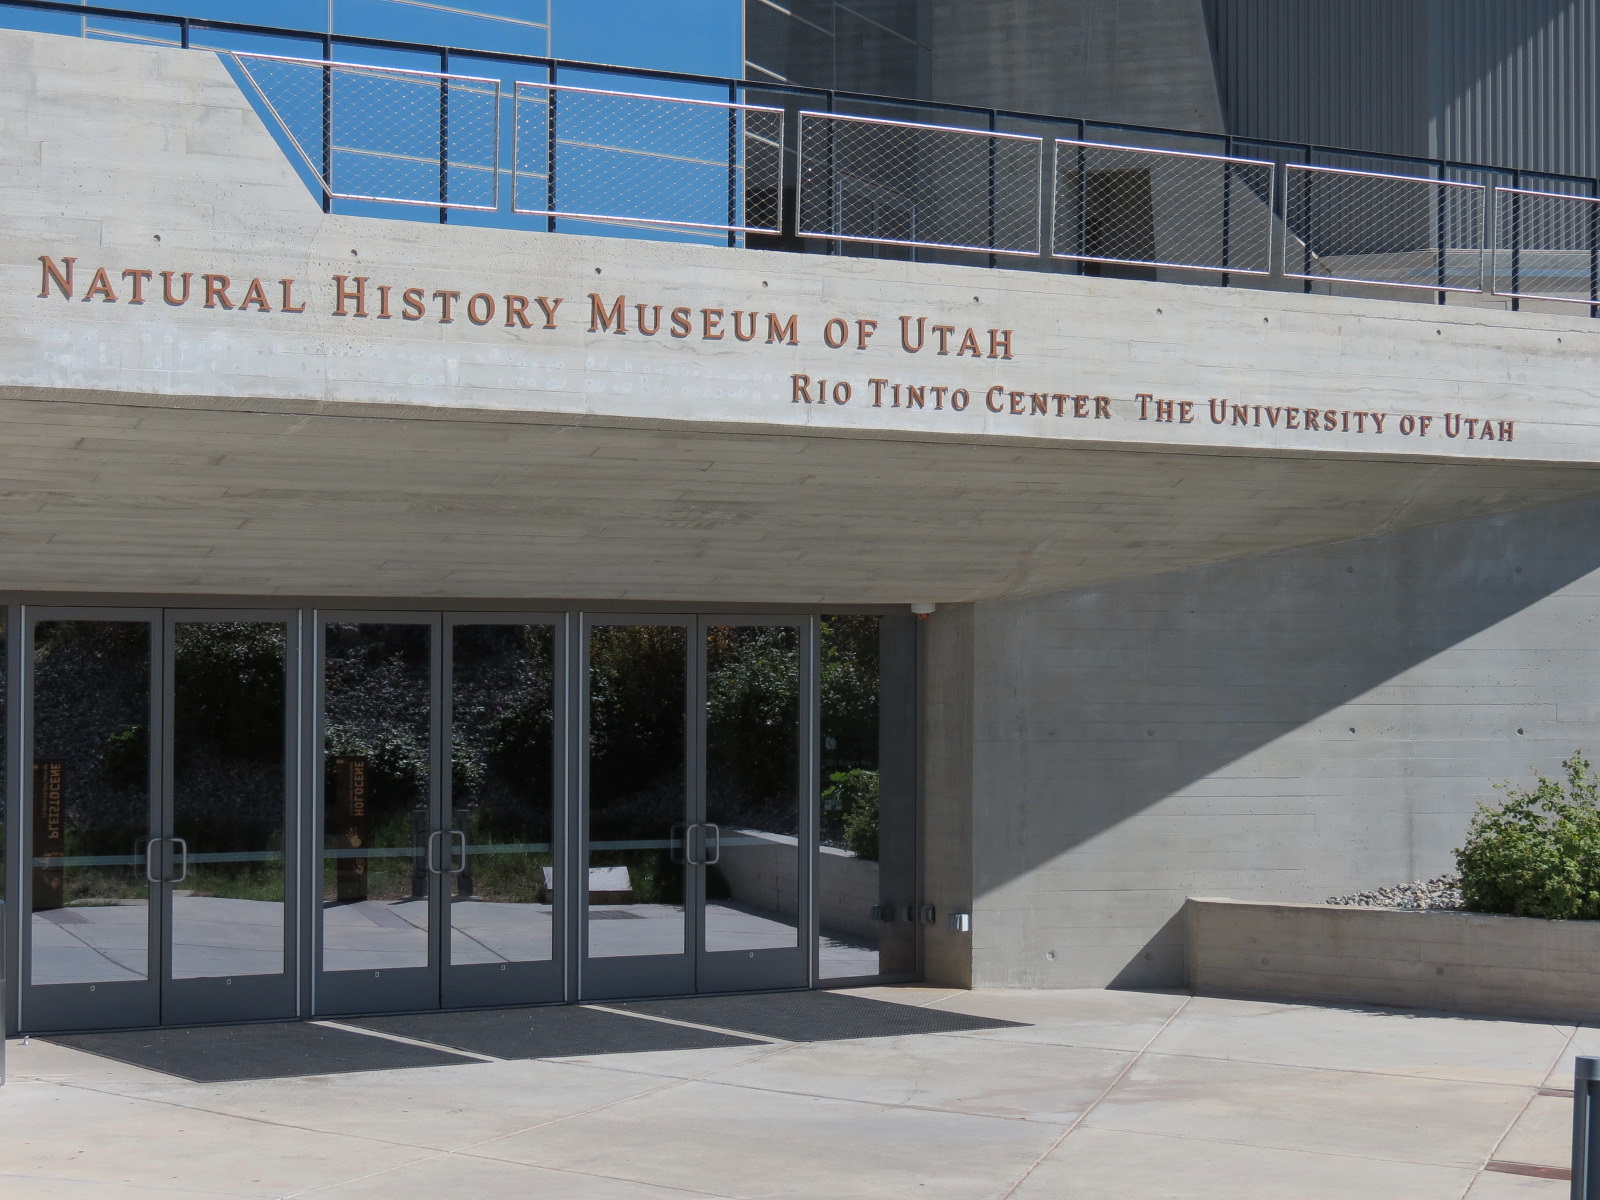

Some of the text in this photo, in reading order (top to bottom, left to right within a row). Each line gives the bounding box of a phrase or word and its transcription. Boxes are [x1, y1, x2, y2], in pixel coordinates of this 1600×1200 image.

[39, 255, 1014, 358] NATURAL HISTORY MUSEUM OF UTAH
[792, 373, 1514, 442] RIO TINTO CENTER THE UNIVERSITY OF UTAH
